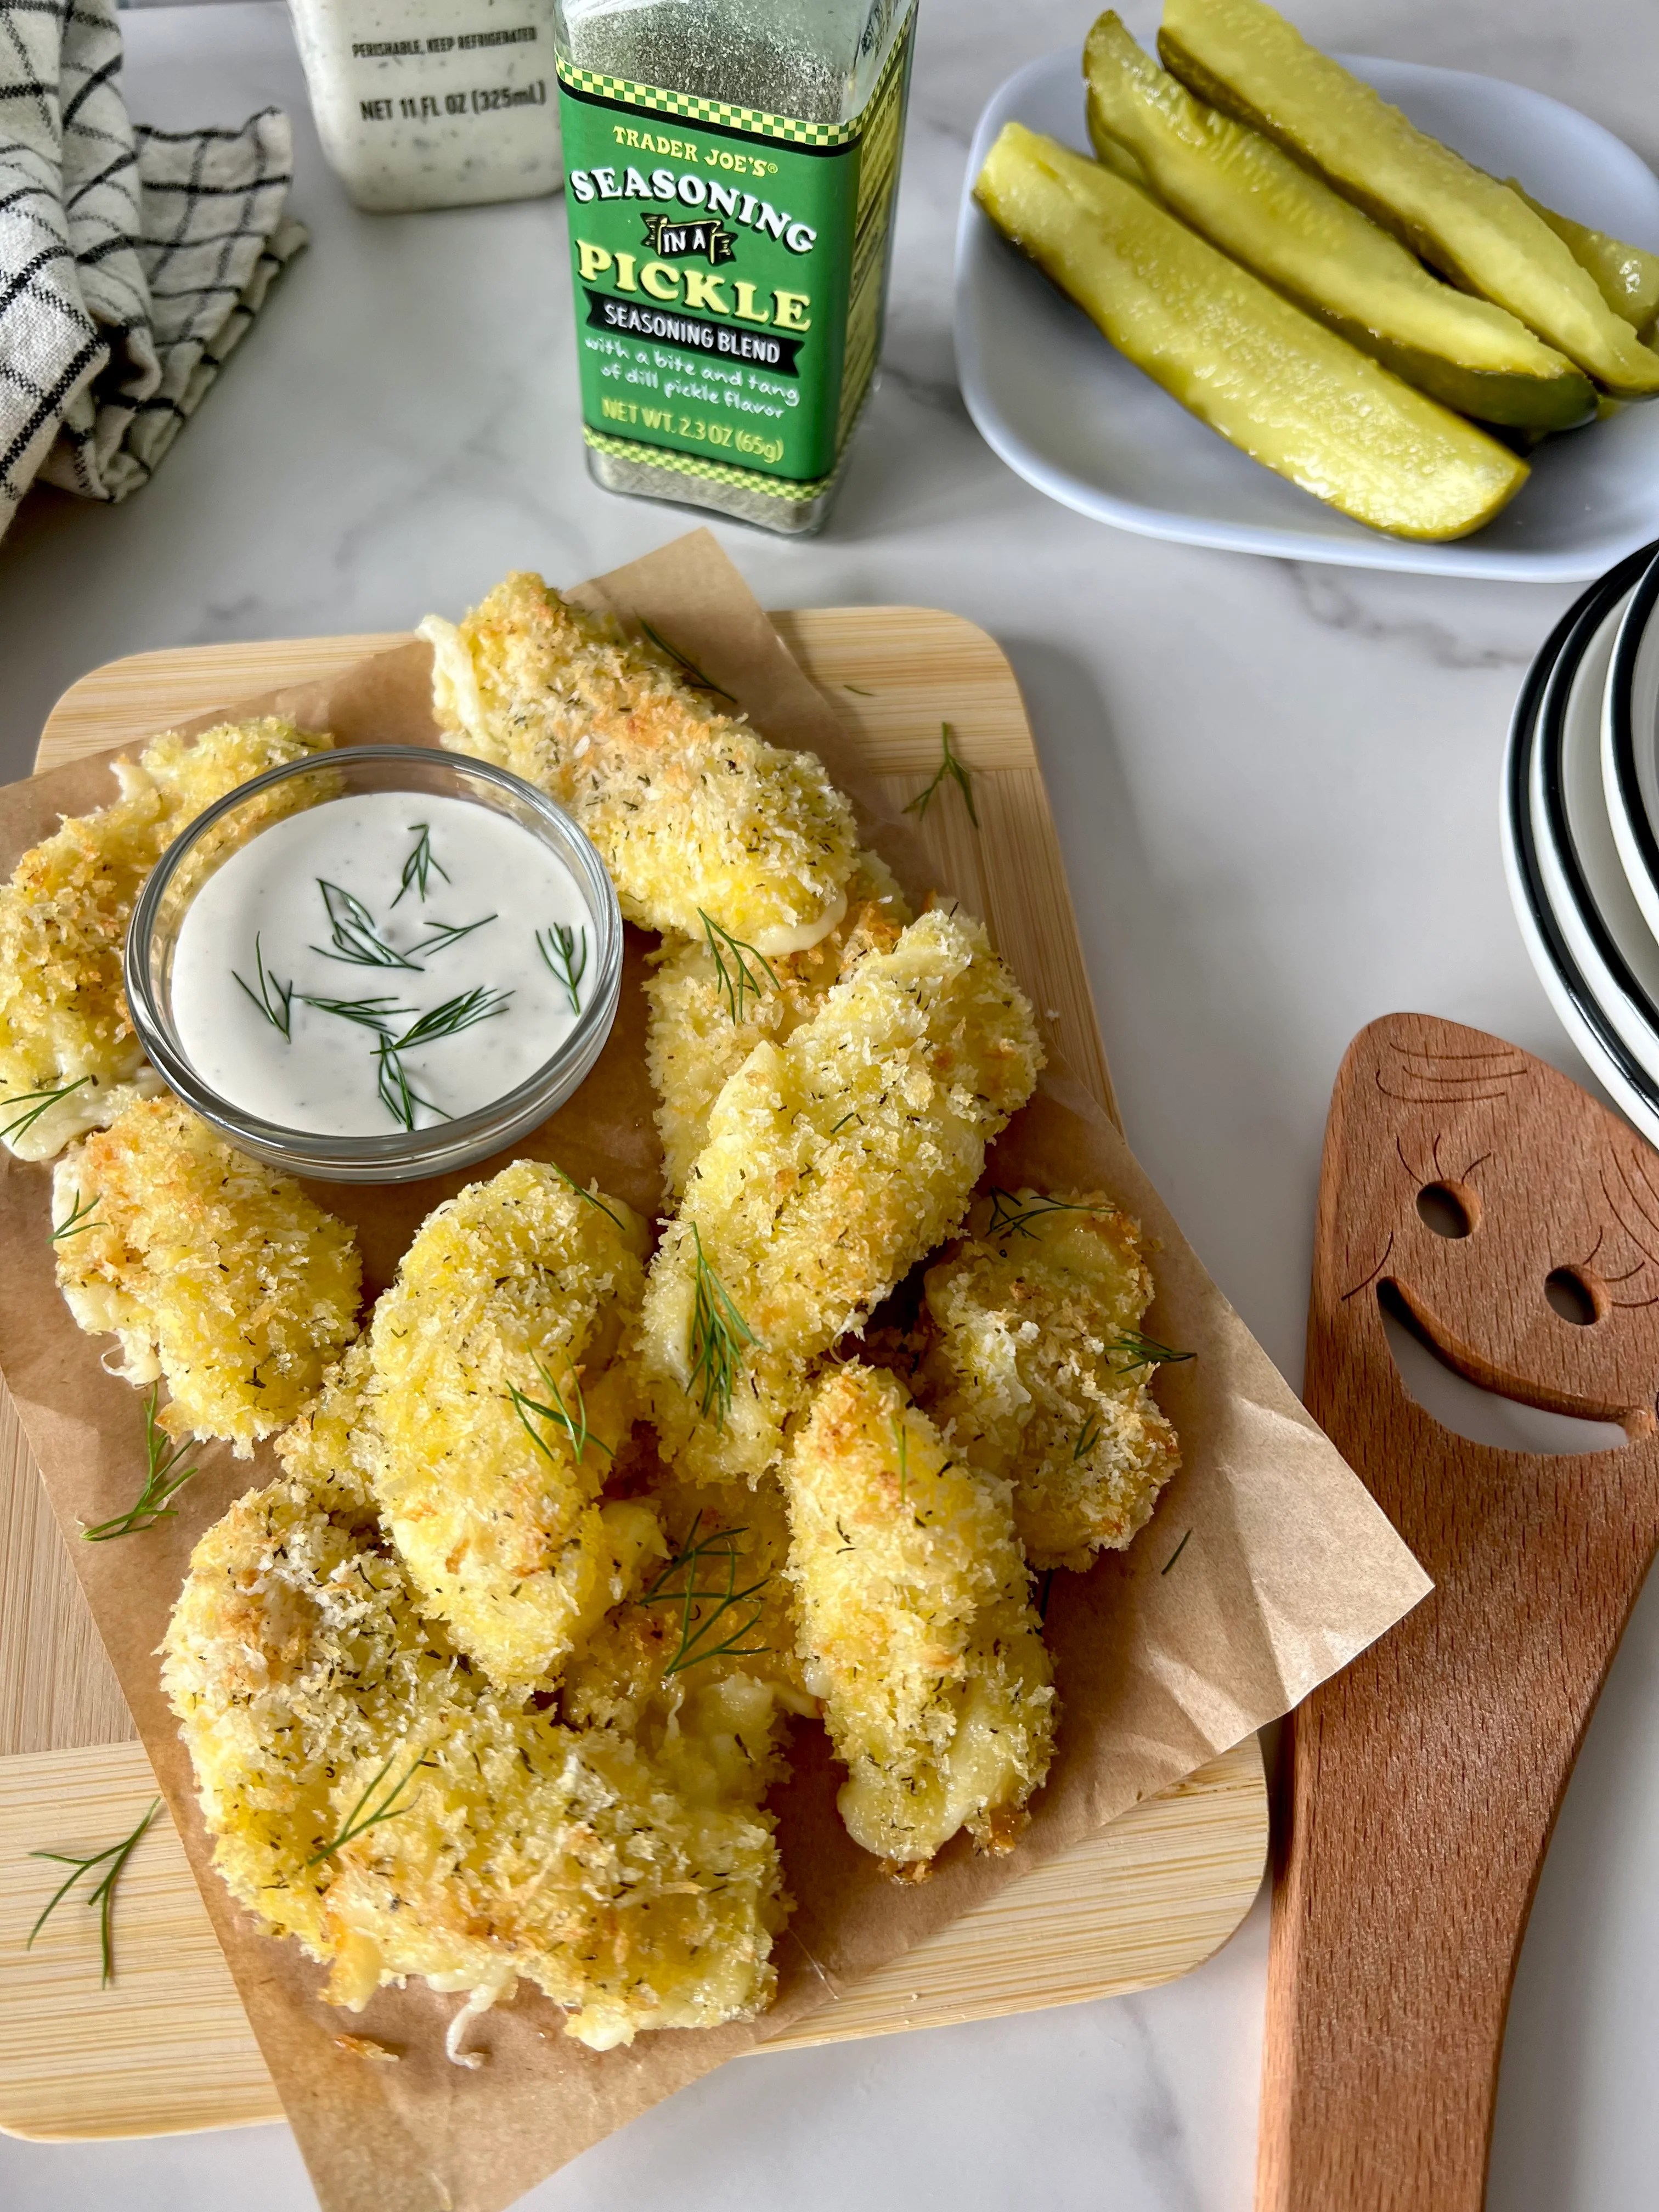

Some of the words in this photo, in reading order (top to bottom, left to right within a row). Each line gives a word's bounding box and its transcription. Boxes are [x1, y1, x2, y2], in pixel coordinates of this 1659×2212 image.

[426, 36, 455, 53] KEEP
[458, 26, 537, 50] REFRIGERATED
[360, 99, 392, 121] NET
[399, 97, 416, 120] 11
[420, 95, 441, 117] FL
[444, 93, 466, 115] OZ
[612, 126, 698, 162] TRADER
[571, 167, 817, 253] SEASONING
[663, 229, 686, 253] IN
[692, 228, 706, 250] A
[575, 239, 811, 332] PICKLE
[603, 303, 714, 348] SEASONING
[718, 326, 780, 363] BLEND
[584, 337, 629, 359] with
[635, 351, 650, 365] a
[653, 350, 696, 376] bite
[701, 368, 743, 387] and
[748, 374, 800, 407] tang
[601, 362, 622, 380] of
[625, 368, 658, 388] dill
[664, 380, 719, 404] pickle
[724, 390, 785, 418] flavor
[602, 397, 637, 424] NET
[641, 407, 676, 433] WT.
[678, 417, 706, 441] 2.3
[708, 425, 733, 447] OZ
[735, 430, 784, 464] (65g)
